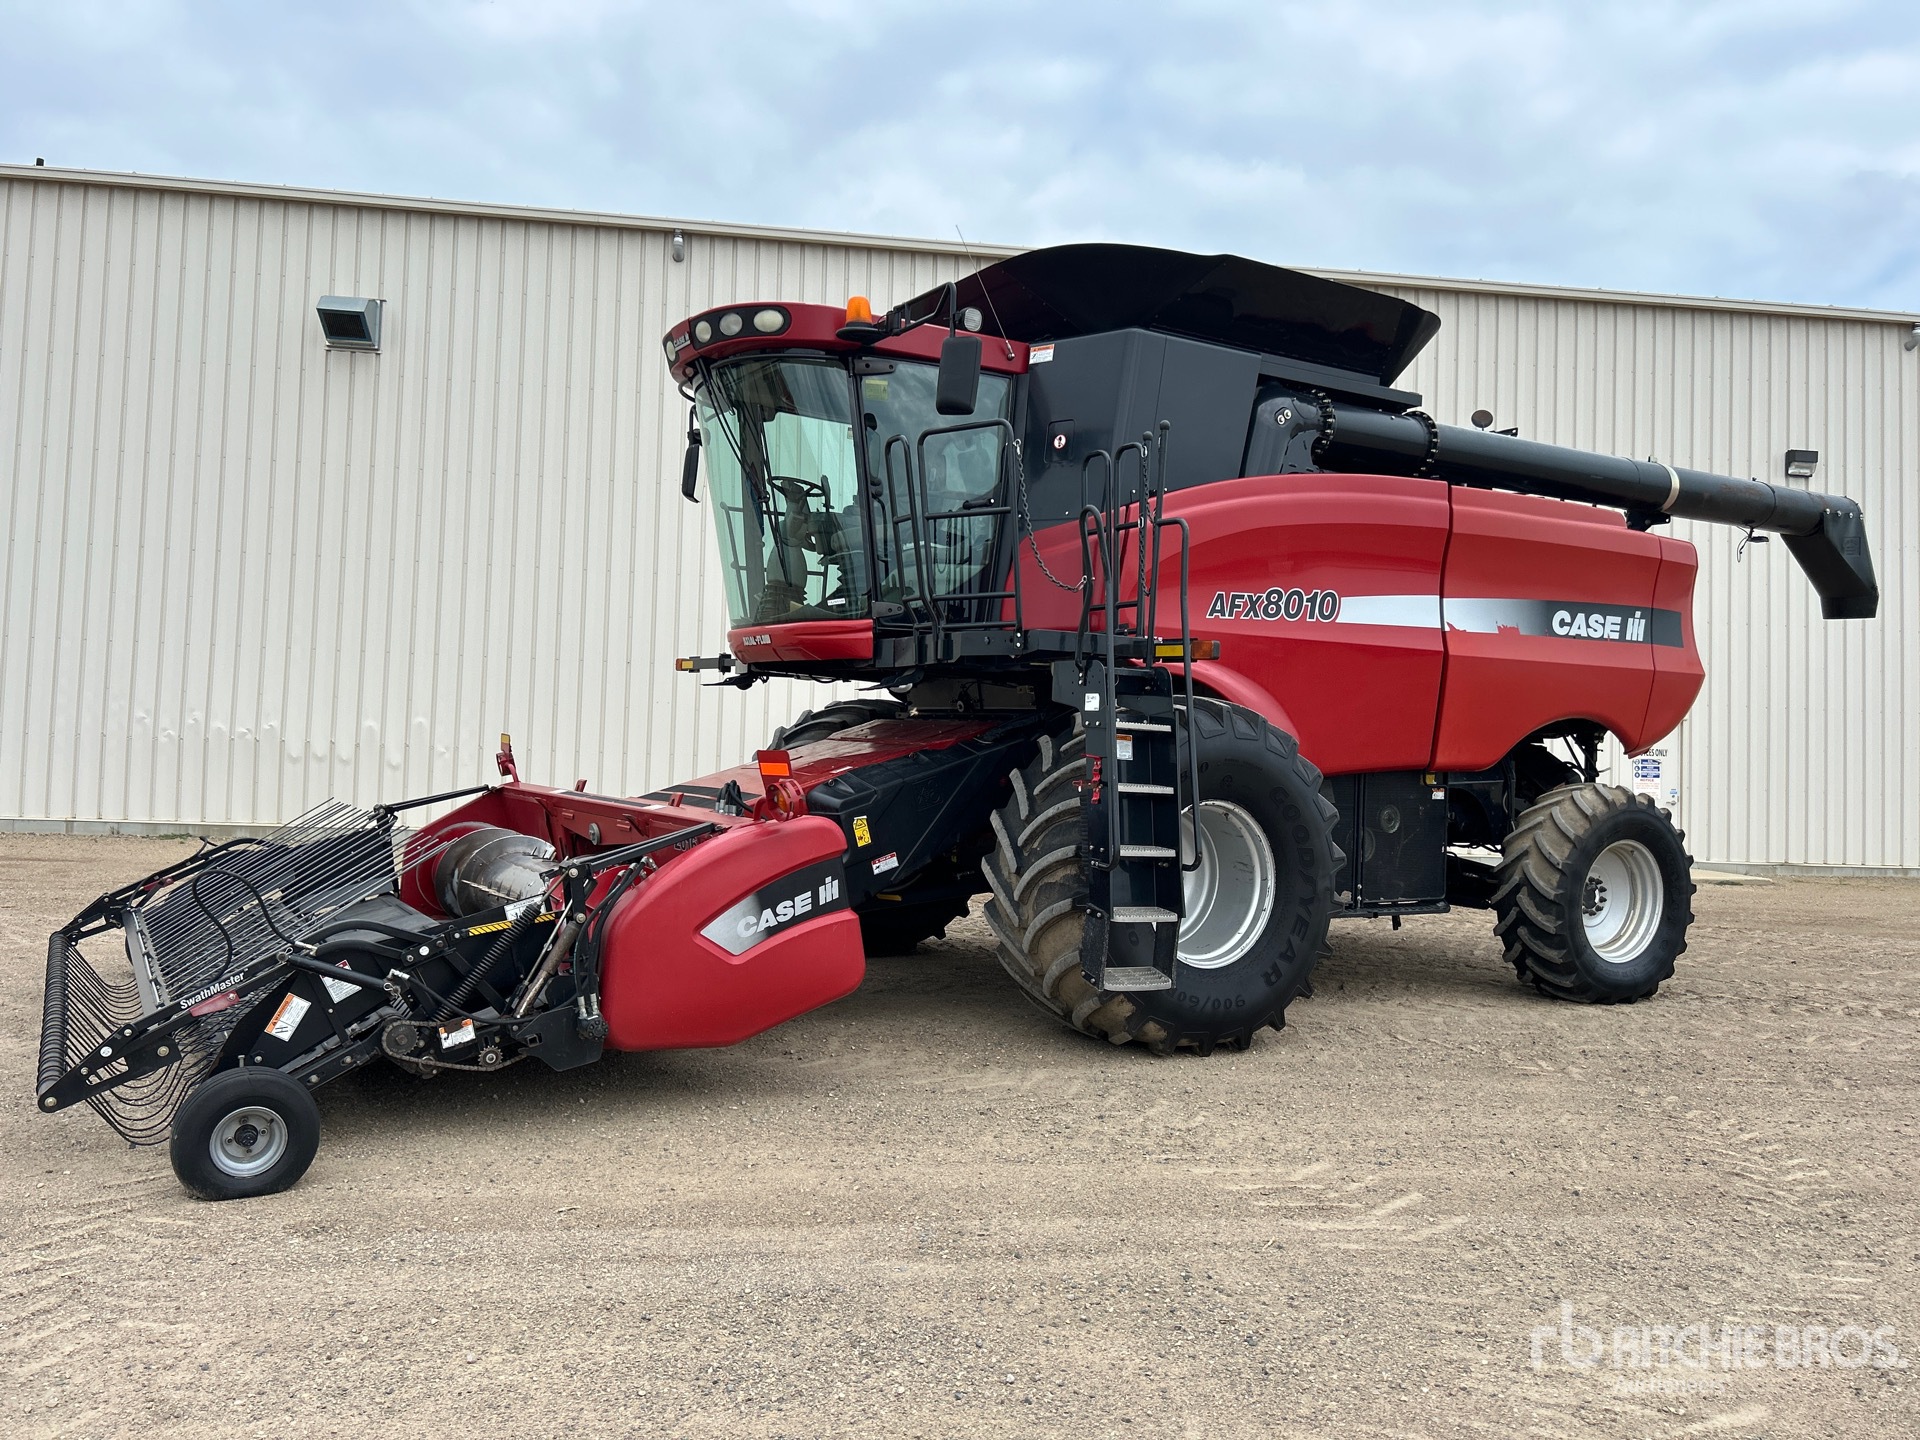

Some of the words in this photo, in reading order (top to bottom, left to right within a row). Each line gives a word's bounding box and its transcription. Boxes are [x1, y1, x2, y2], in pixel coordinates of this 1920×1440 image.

[1206, 587, 1339, 622] AFX8010
[1551, 610, 1622, 639] CASE
[1655, 749, 1668, 757] ONLY
[1260, 786, 1318, 988] GOODYEAR
[736, 890, 812, 938] CASE
[180, 972, 246, 1010] SwathMaster
